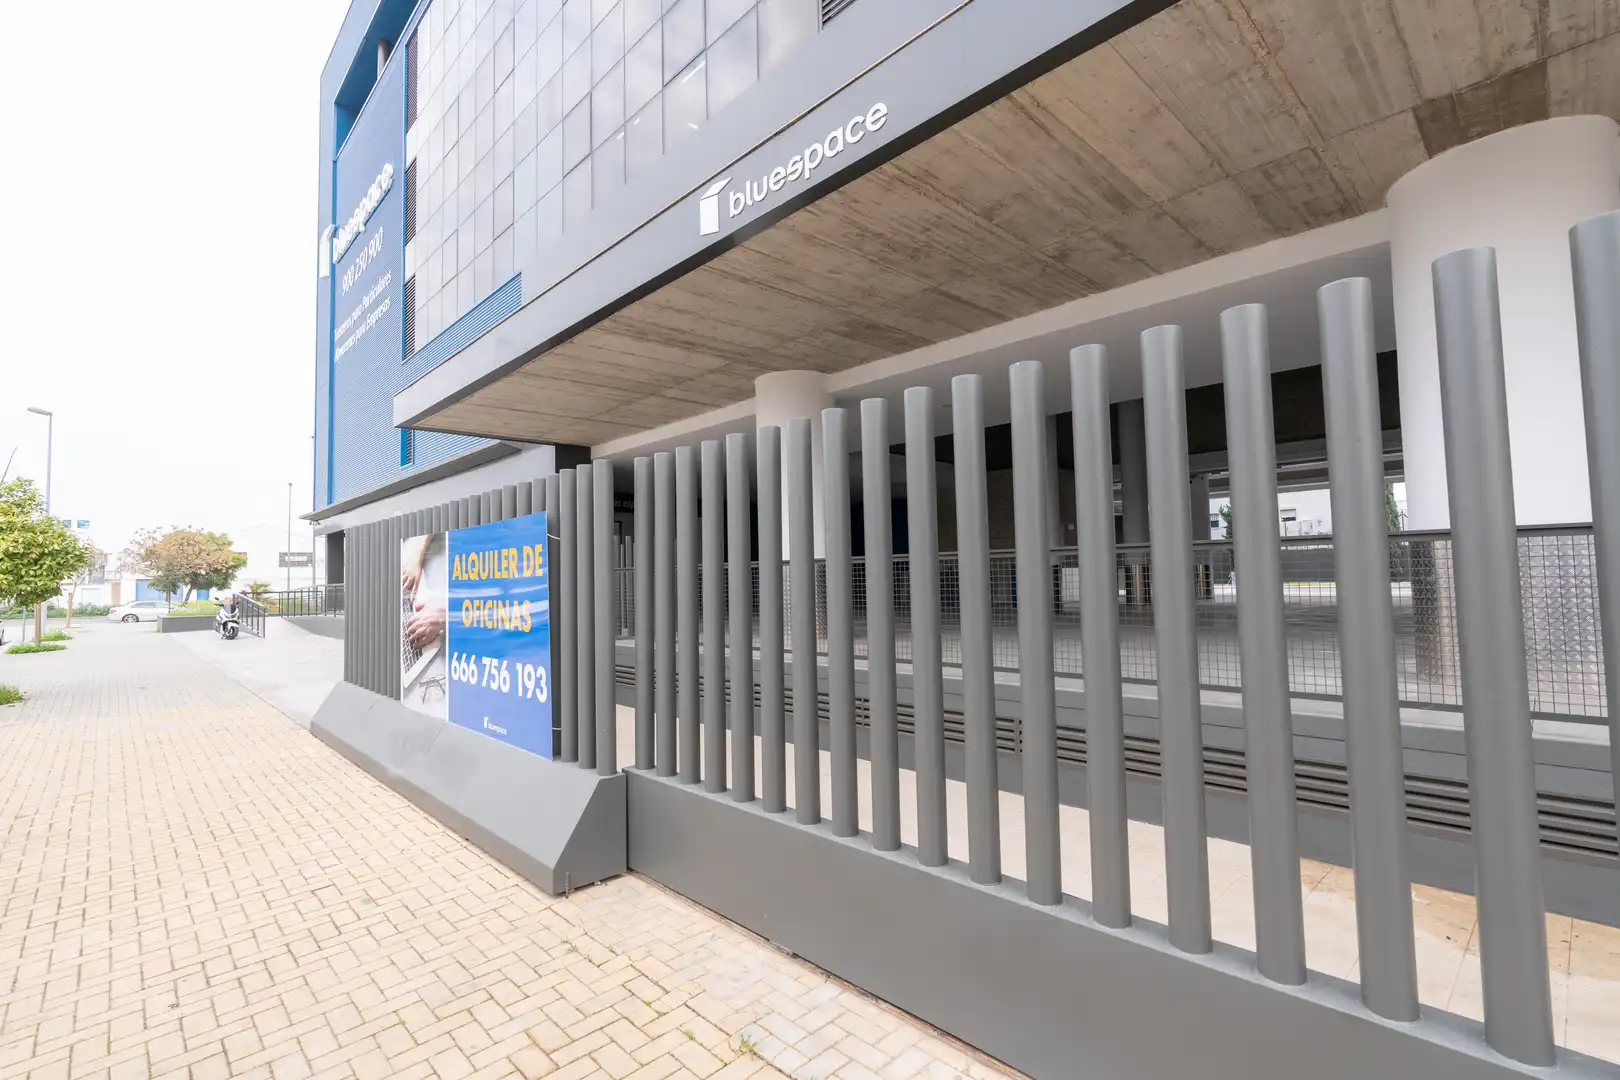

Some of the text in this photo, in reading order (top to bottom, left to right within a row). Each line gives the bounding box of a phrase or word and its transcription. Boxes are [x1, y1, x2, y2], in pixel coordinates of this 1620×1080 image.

[729, 102, 888, 218] bluespace
[342, 226, 384, 296] 900 250 900
[363, 270, 392, 309] Particulares
[366, 296, 391, 331] Empresas
[452, 543, 544, 580] ALQUILER DE
[461, 599, 532, 633] OFICINAS
[451, 651, 548, 703] 666 756 193
